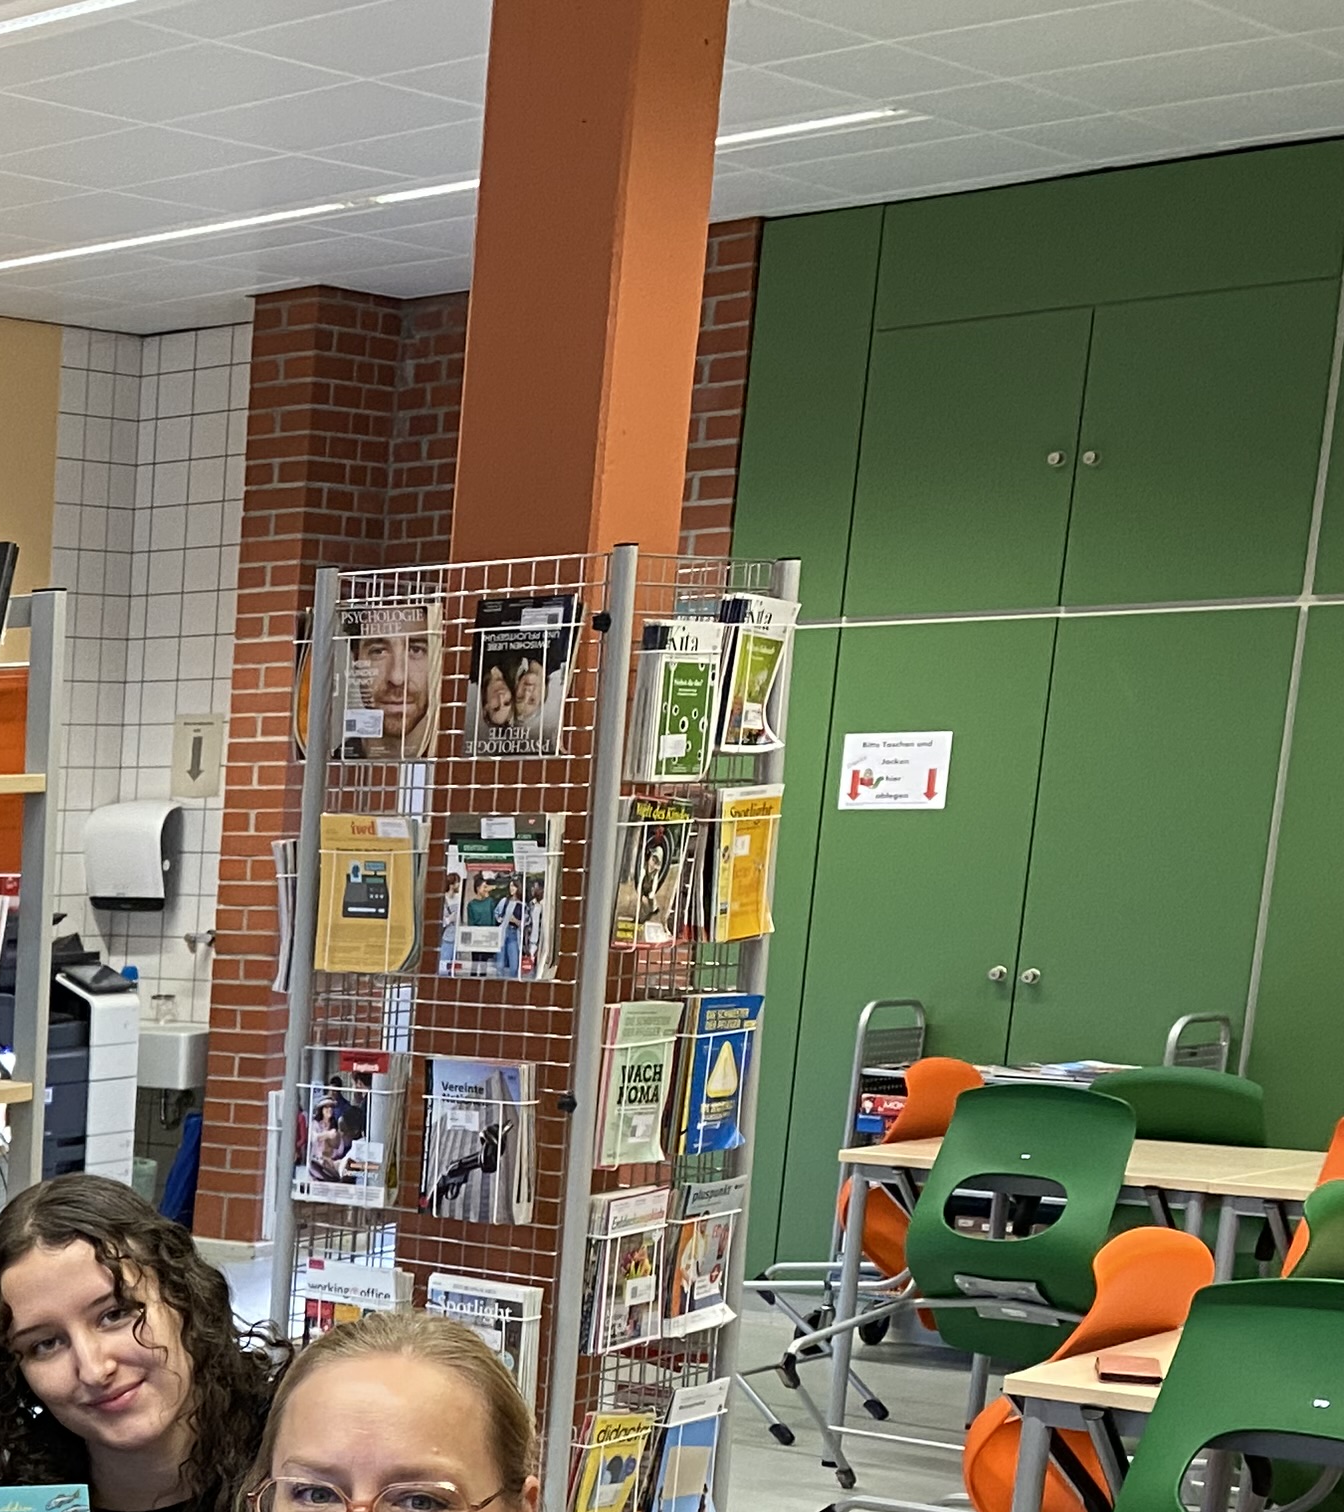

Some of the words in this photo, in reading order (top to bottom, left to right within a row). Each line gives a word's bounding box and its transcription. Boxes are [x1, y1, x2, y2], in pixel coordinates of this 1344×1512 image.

[340, 607, 425, 626] PSYCHOLOGIE
[359, 622, 403, 636] HEUTE
[667, 625, 699, 652] Kita
[488, 726, 532, 740] HEUTE
[464, 738, 552, 755] PSYCHOLOGIE
[917, 740, 933, 748] und
[653, 806, 666, 821] des
[351, 820, 377, 837] iwd
[621, 1063, 664, 1084] WACH
[441, 1080, 485, 1096] Vereinte
[616, 1084, 660, 1105] KOMA
[692, 1184, 732, 1205] pluspunkt
[435, 1294, 513, 1323] Spotlight
